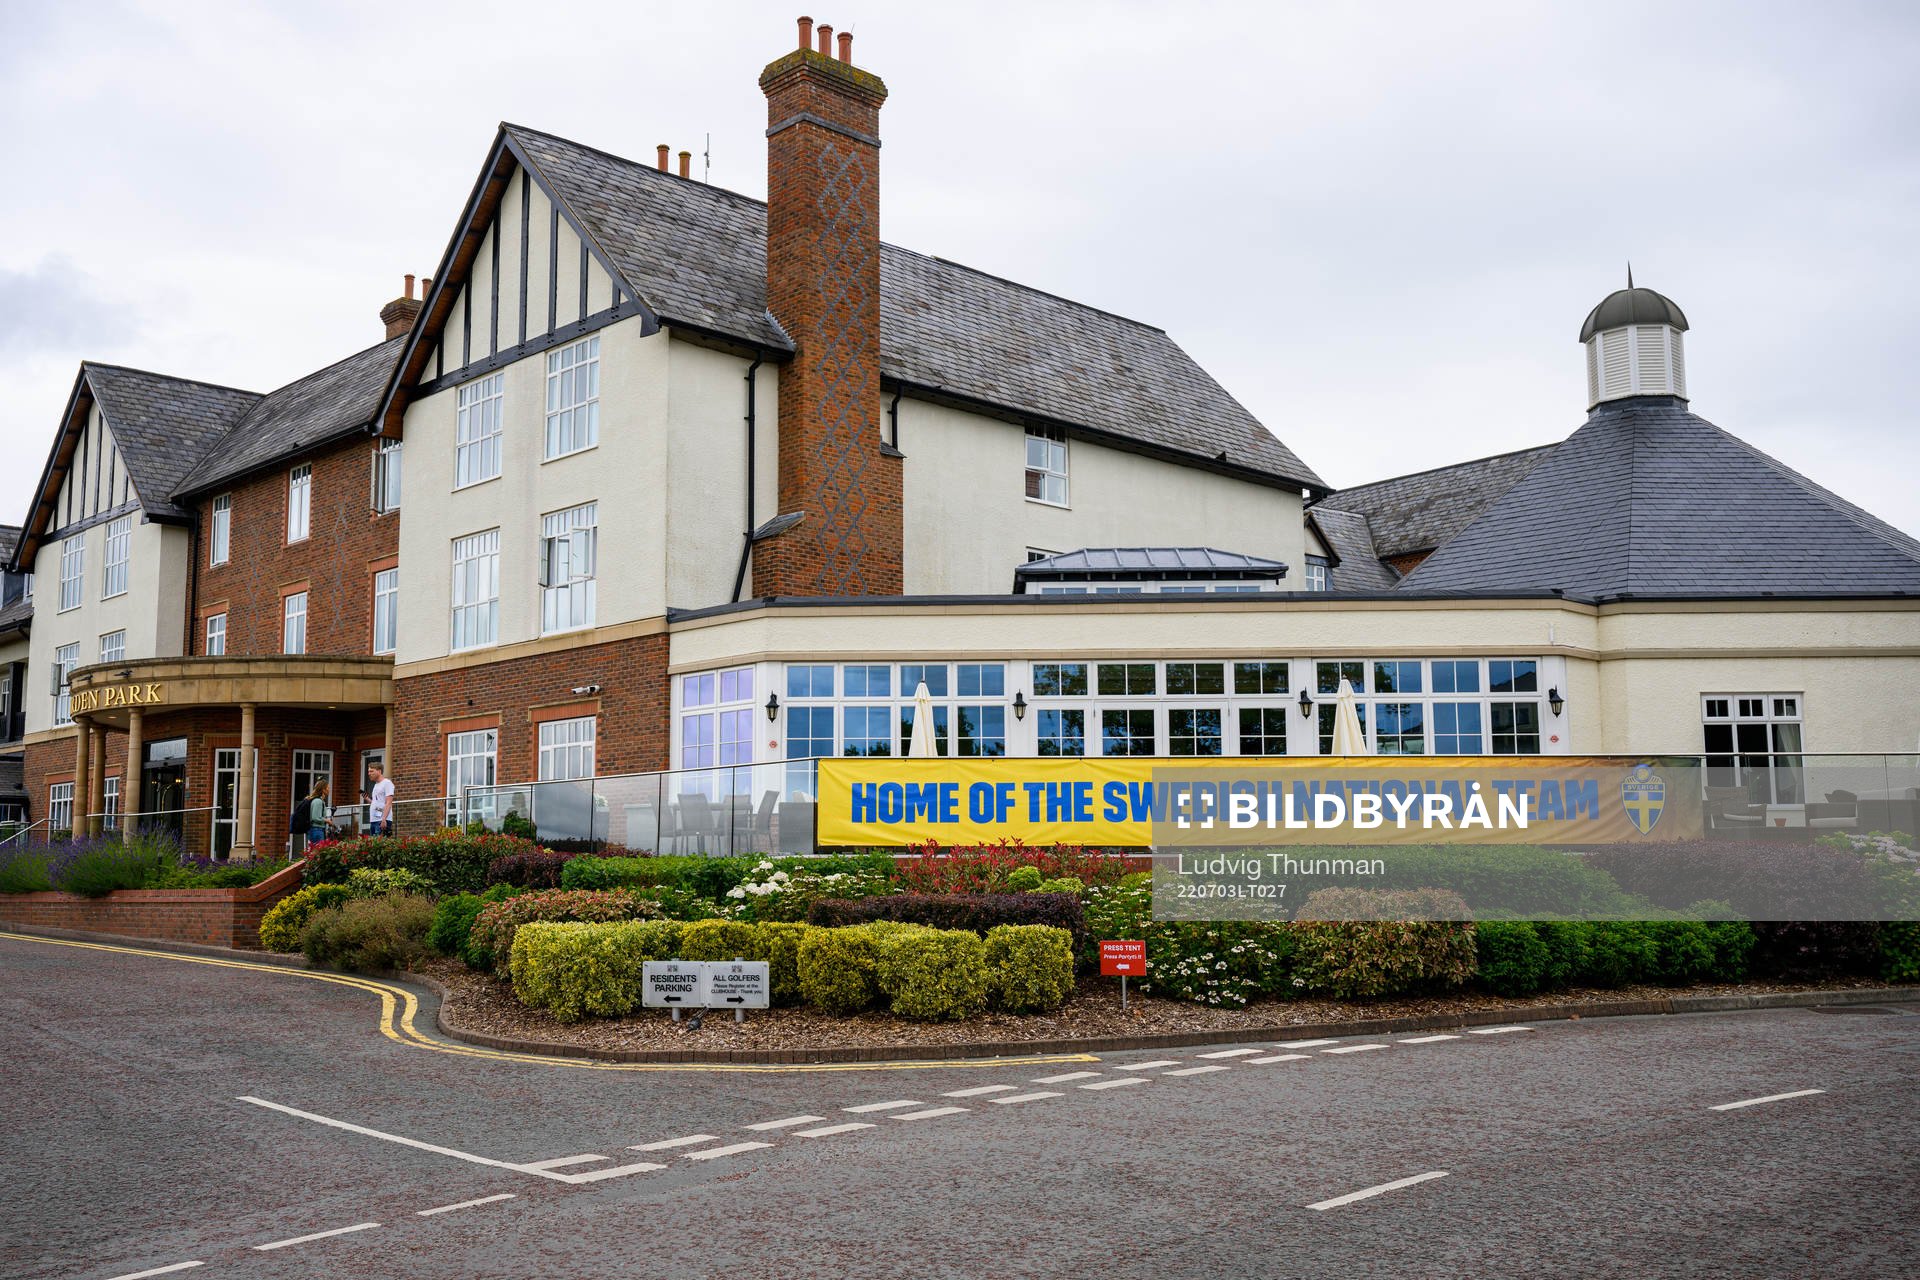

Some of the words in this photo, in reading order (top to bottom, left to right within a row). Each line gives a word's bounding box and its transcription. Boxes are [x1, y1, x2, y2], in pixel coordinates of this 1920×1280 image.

[104, 683, 161, 706] PARK
[851, 781, 960, 824] HOME
[968, 781, 1016, 824] OF
[1023, 781, 1094, 823] THE
[1103, 780, 1283, 823] SWEDISH
[1491, 779, 1600, 821] TEAM
[650, 974, 697, 983] RESIDENTS
[654, 984, 692, 992] PARKING
